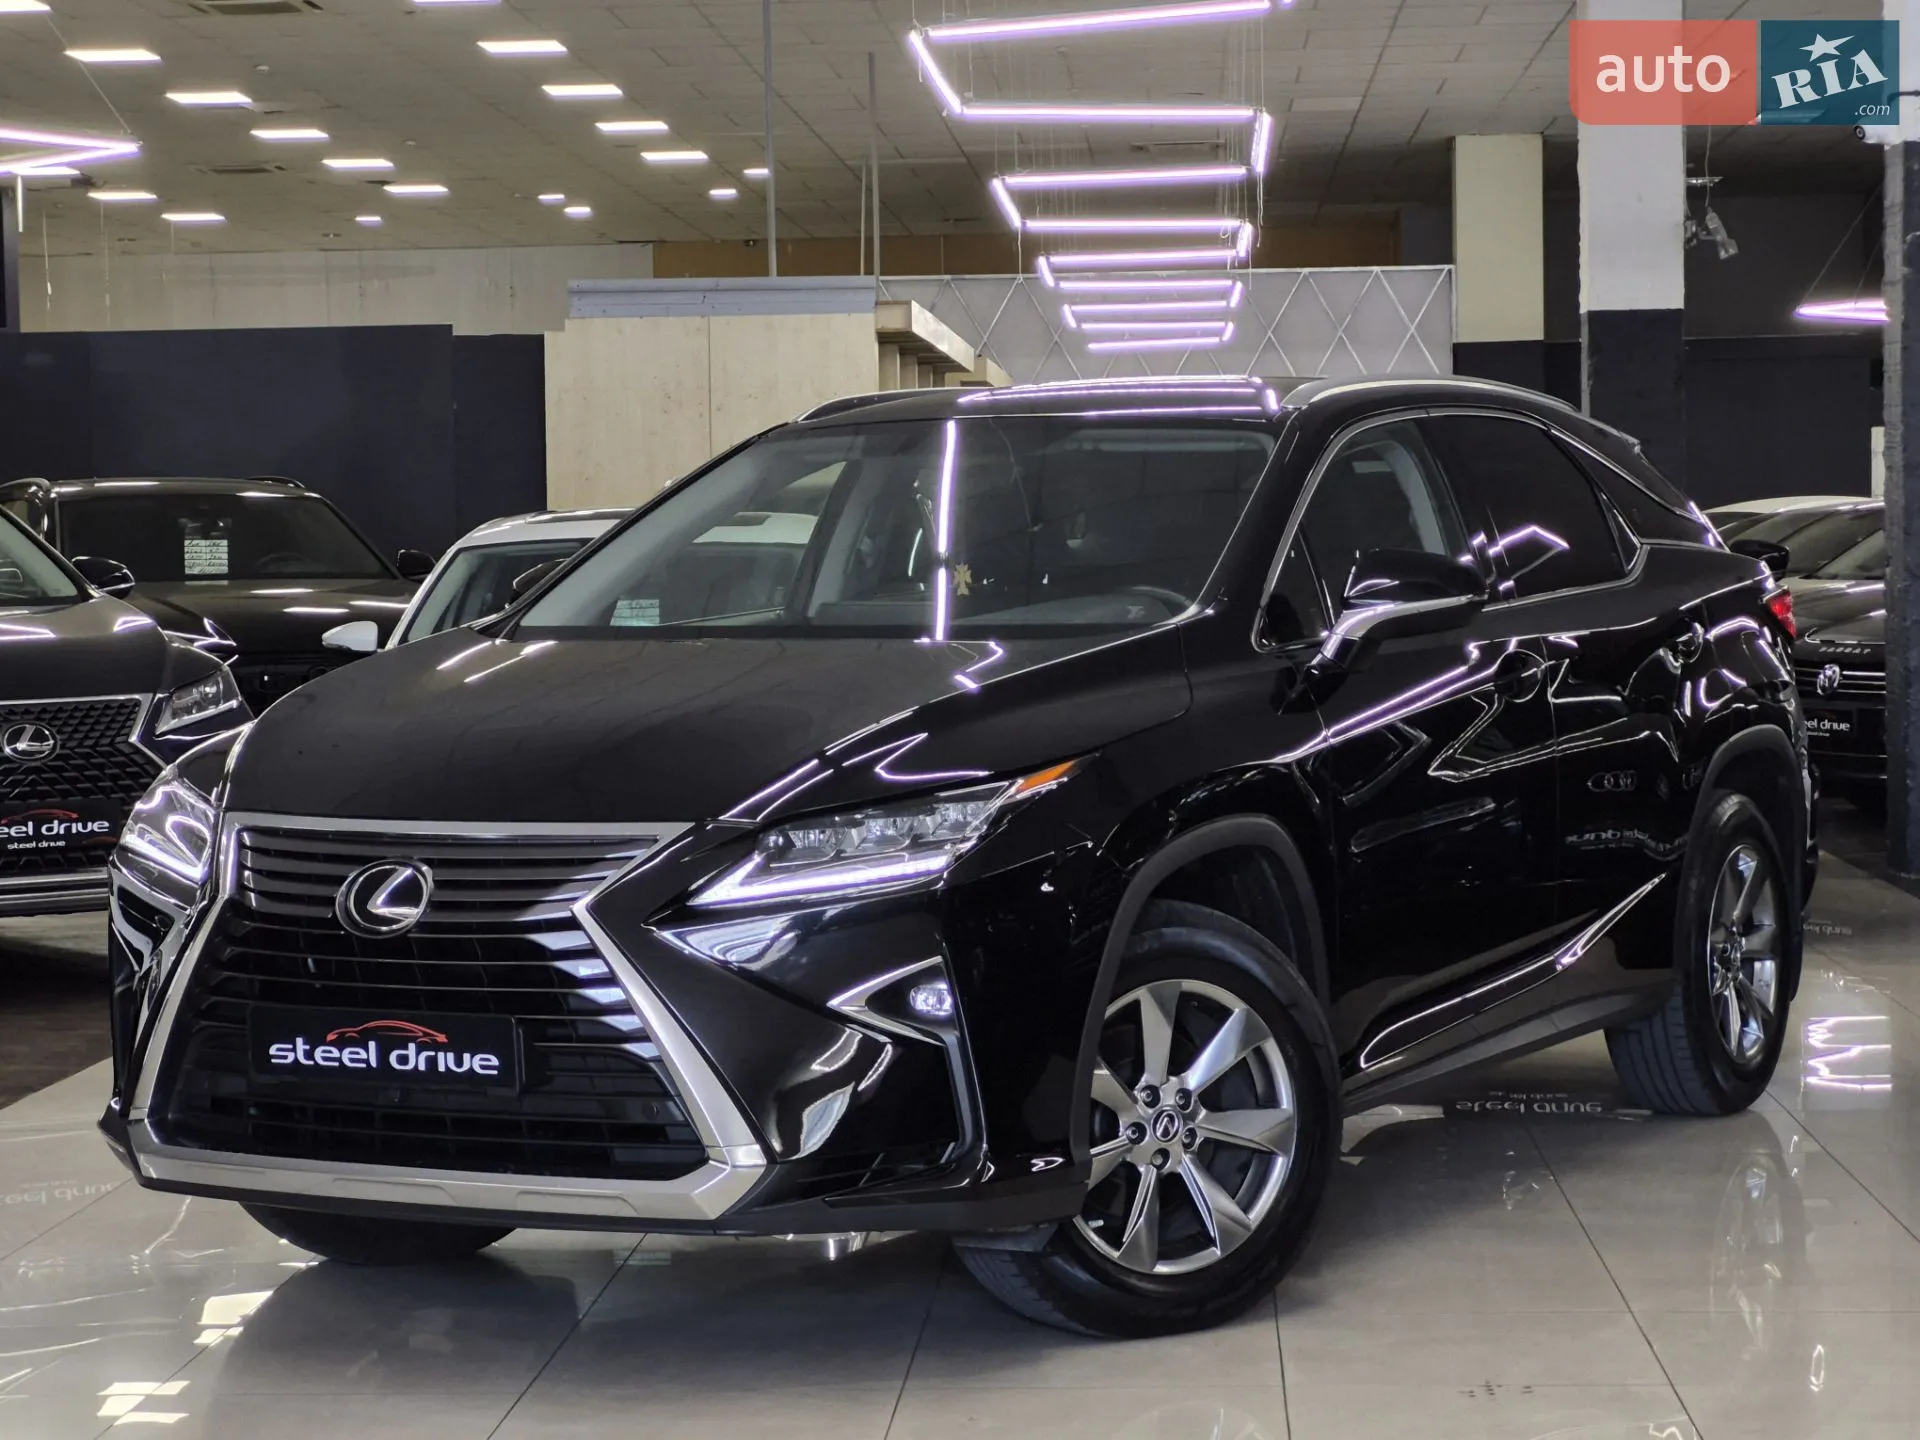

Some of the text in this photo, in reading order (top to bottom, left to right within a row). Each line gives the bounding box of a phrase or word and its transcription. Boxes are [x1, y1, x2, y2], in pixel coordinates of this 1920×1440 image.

[41, 819, 110, 835] drive
[7, 839, 66, 850] steel drive
[268, 1037, 499, 1075] steel drive
